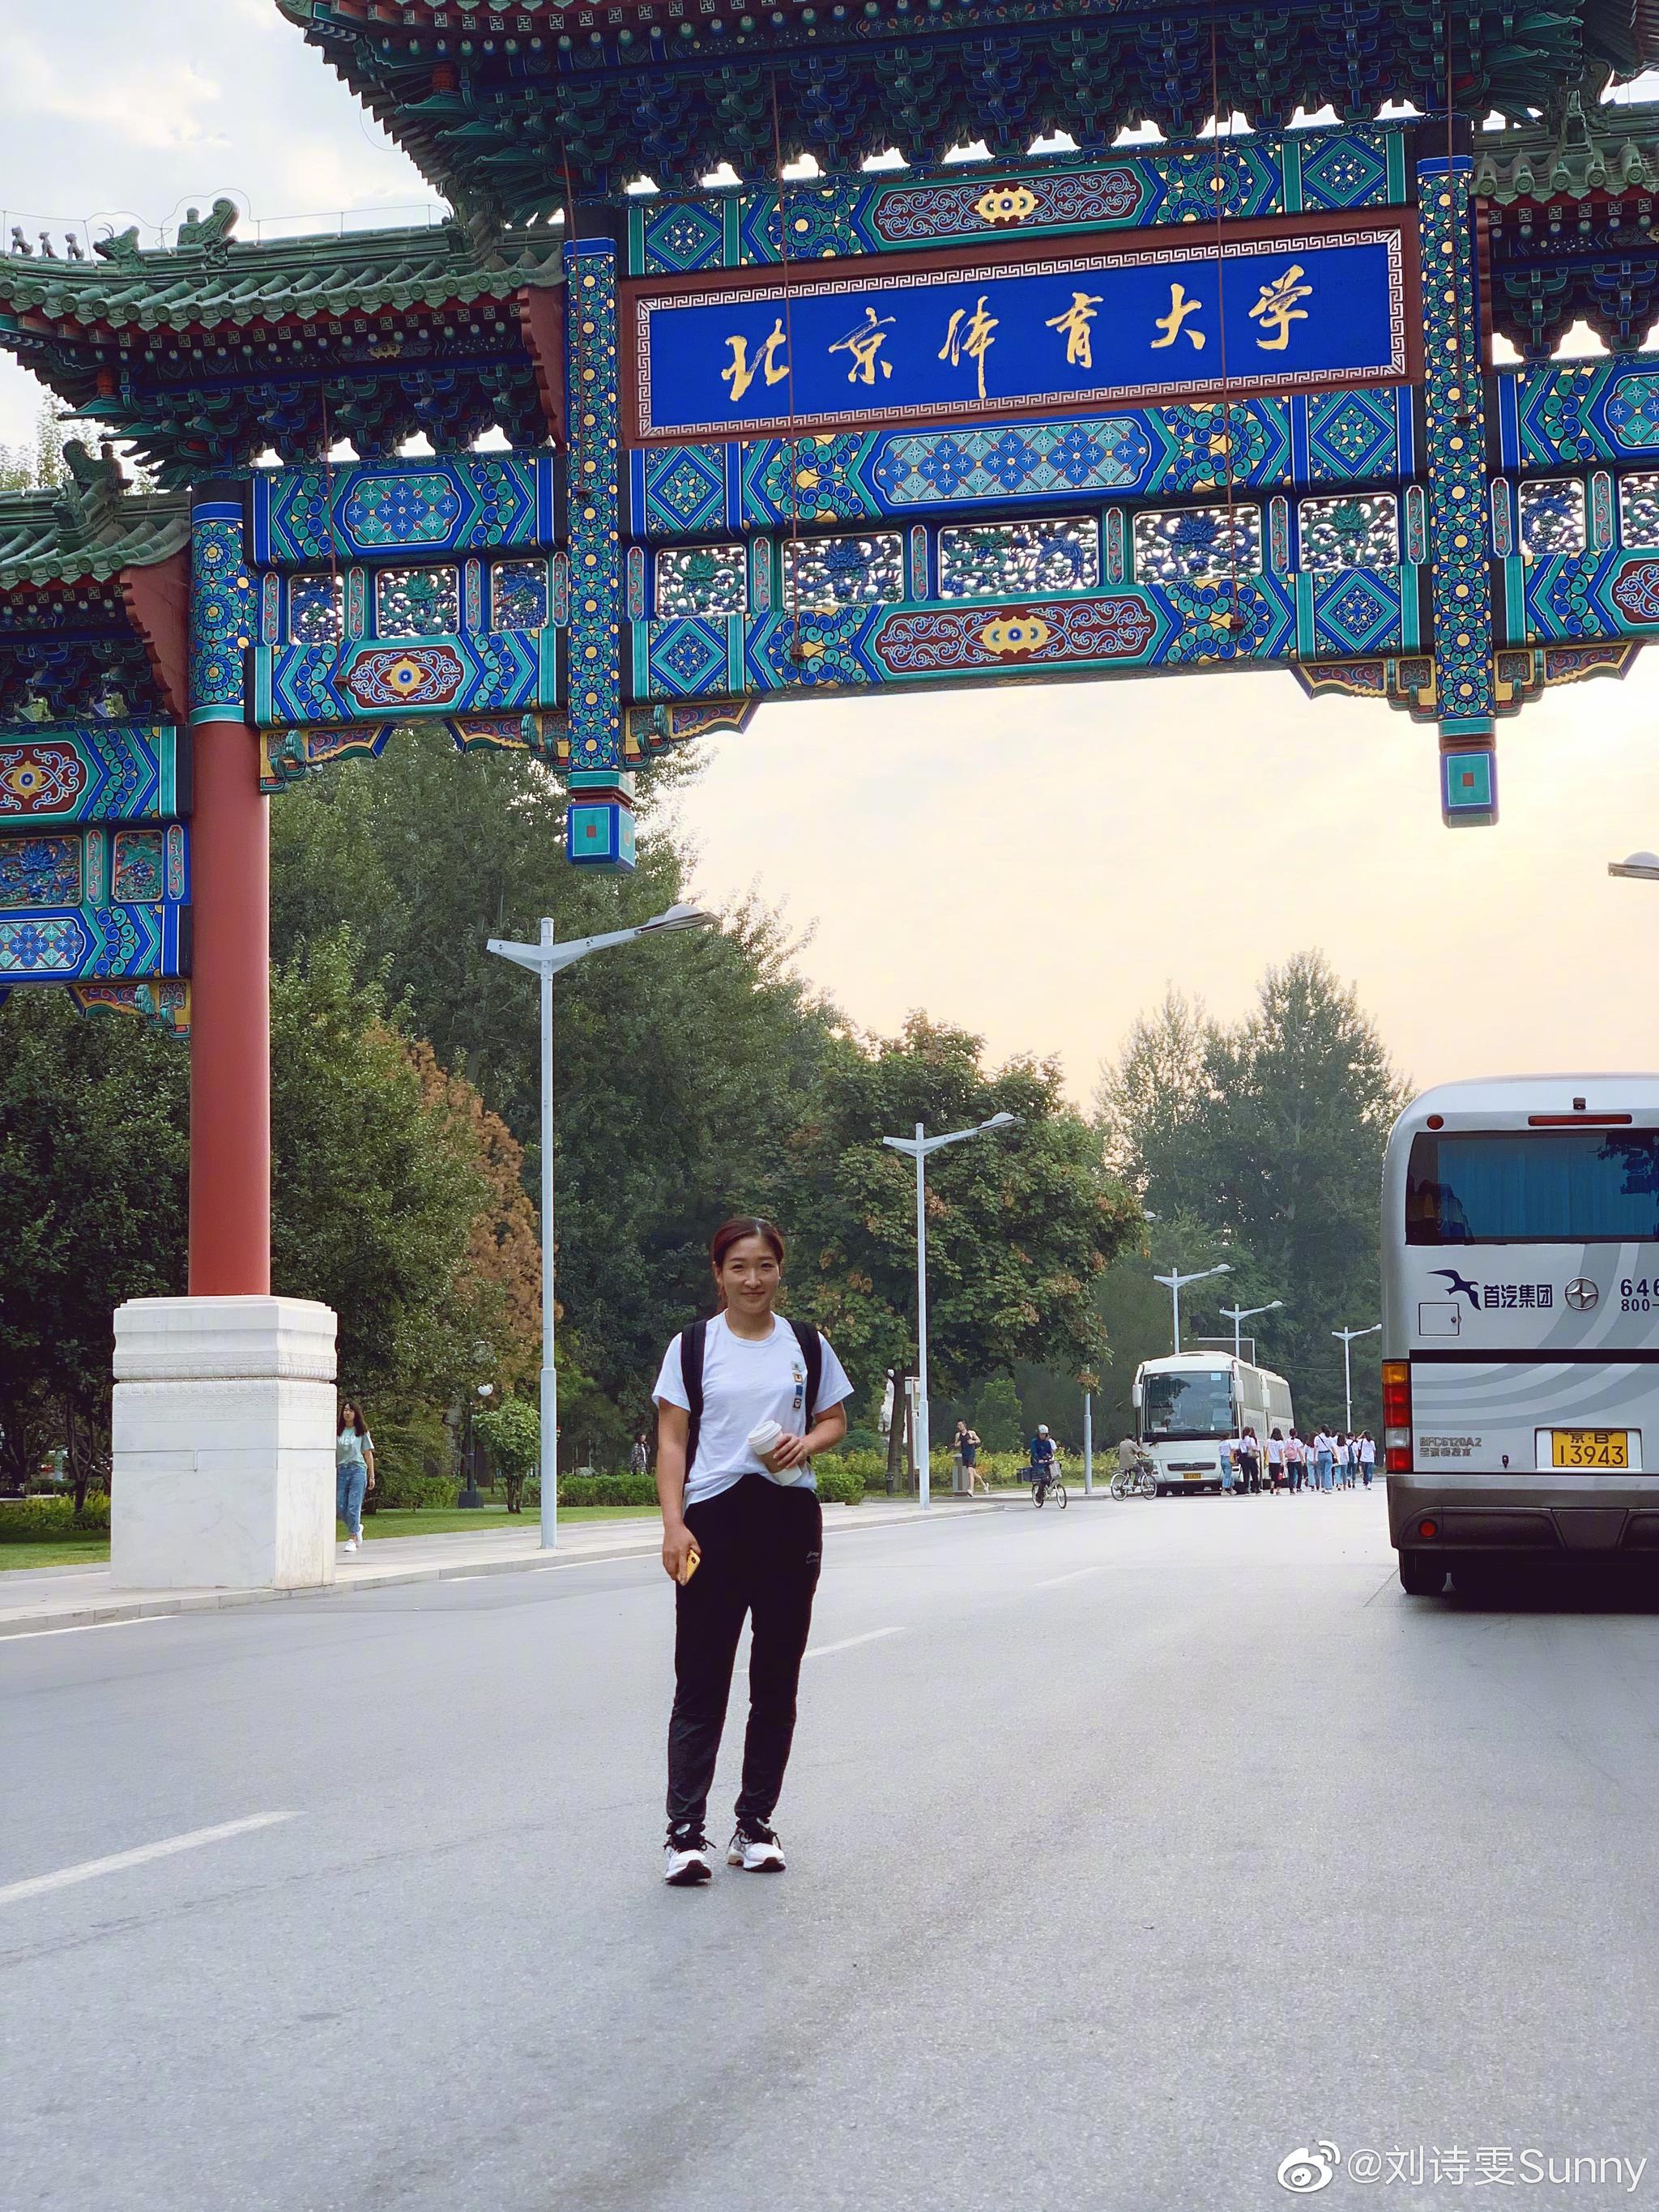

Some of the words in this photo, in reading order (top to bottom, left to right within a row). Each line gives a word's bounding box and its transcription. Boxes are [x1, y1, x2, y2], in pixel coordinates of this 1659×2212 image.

[720, 264, 1313, 399] 北京体育大学
[1484, 1285, 1553, 1308] 首汽集团
[1560, 1445, 1624, 1464] 13943
